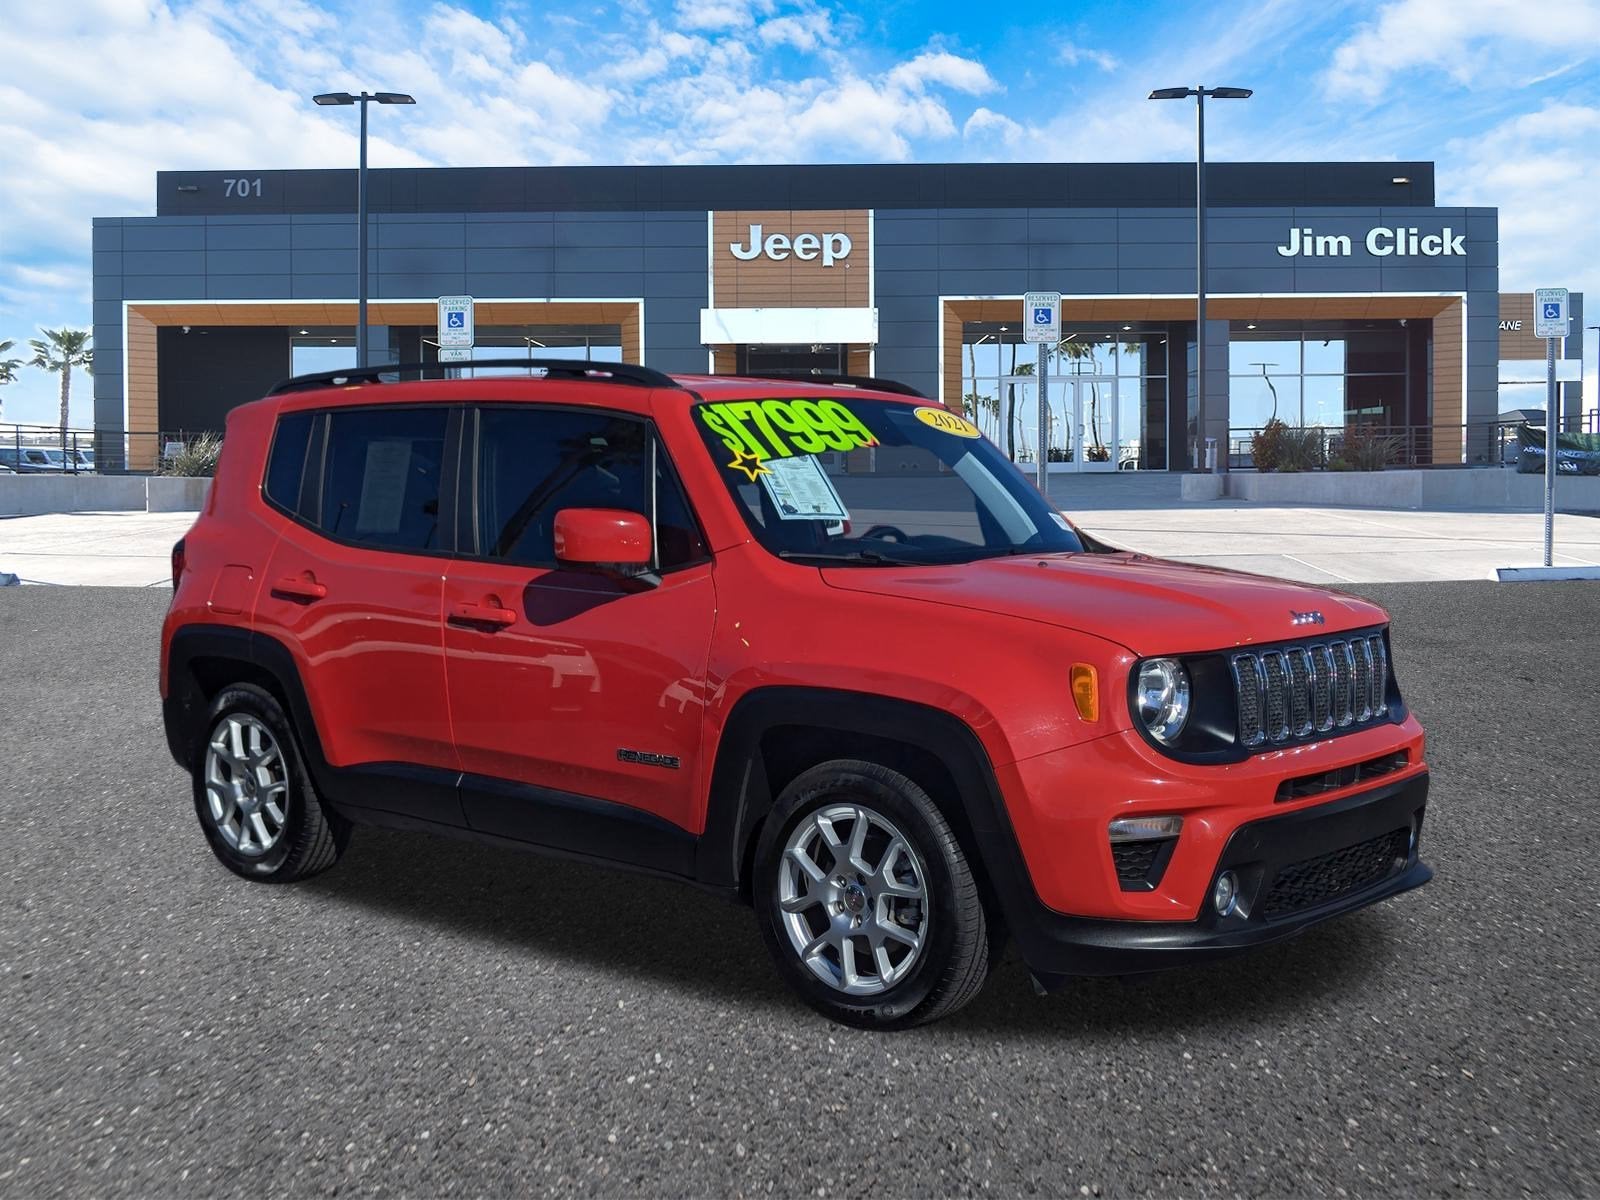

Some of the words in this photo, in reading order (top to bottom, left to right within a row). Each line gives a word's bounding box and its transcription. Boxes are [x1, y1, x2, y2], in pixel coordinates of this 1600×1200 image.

[223, 178, 261, 197] 701
[730, 224, 852, 267] Jeep
[1277, 228, 1352, 256] Jim
[1366, 227, 1467, 256] Click
[441, 298, 470, 306] RESERVED
[699, 400, 878, 459] $17999
[927, 412, 969, 432] 2021
[617, 748, 680, 769] RENEGADE
